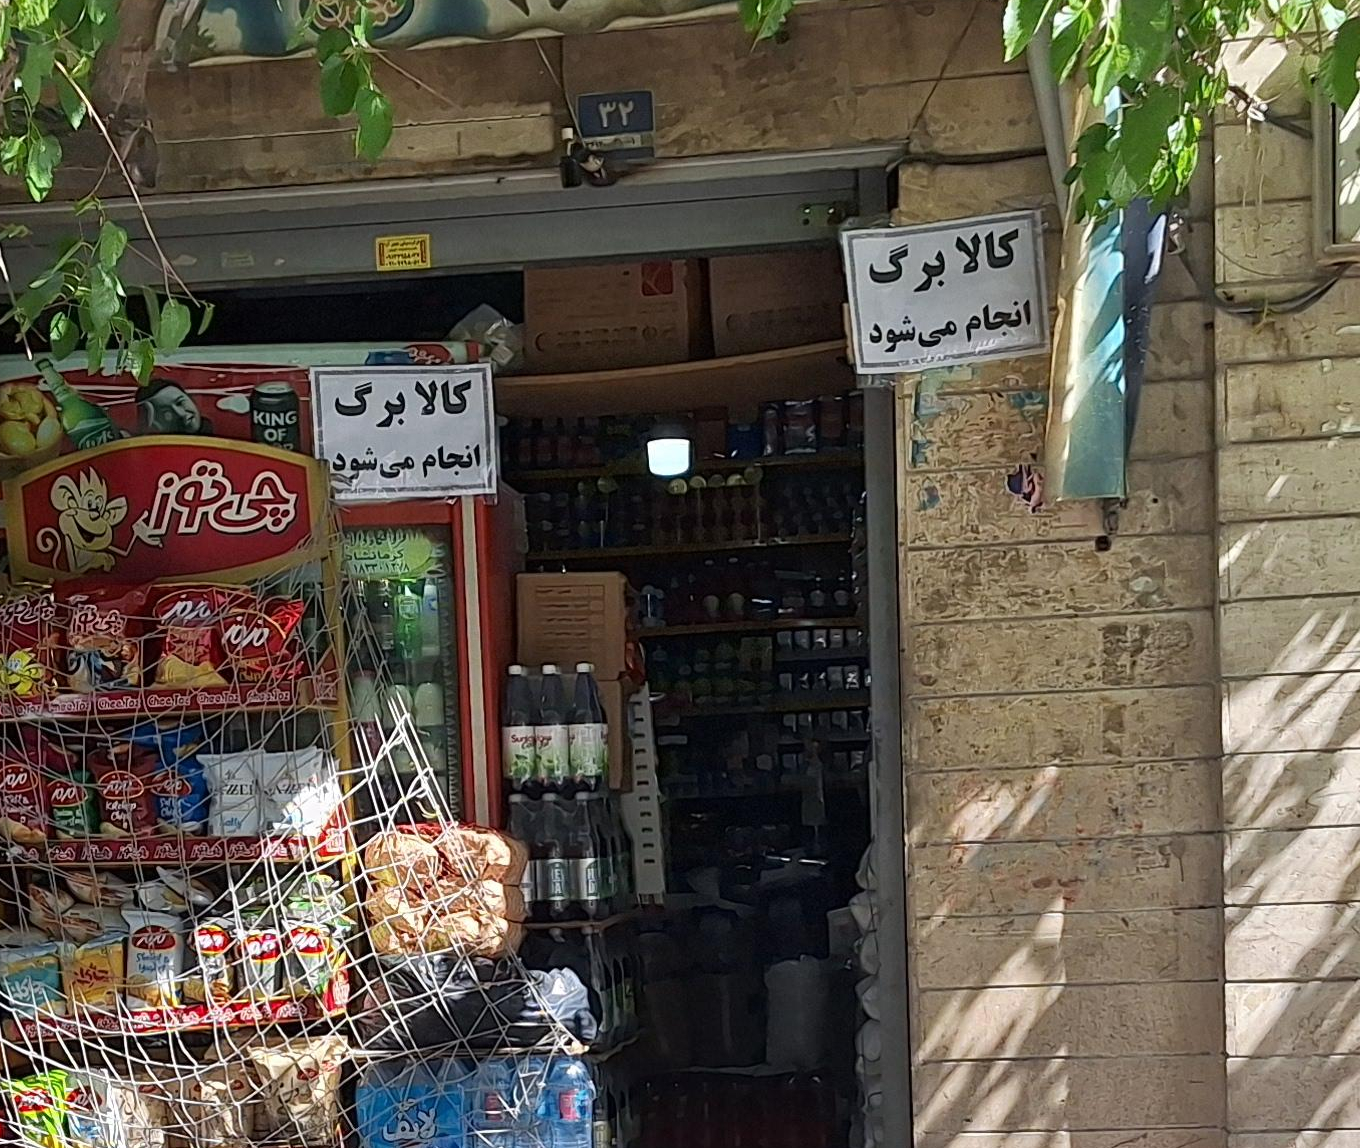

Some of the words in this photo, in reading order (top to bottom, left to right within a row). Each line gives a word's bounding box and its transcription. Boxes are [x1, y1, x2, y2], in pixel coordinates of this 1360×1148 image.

[598, 100, 634, 128] ۳۲
[965, 299, 1031, 342] انجام
[252, 410, 298, 427] KING
[263, 428, 288, 442] OF
[422, 444, 481, 478] انجام
